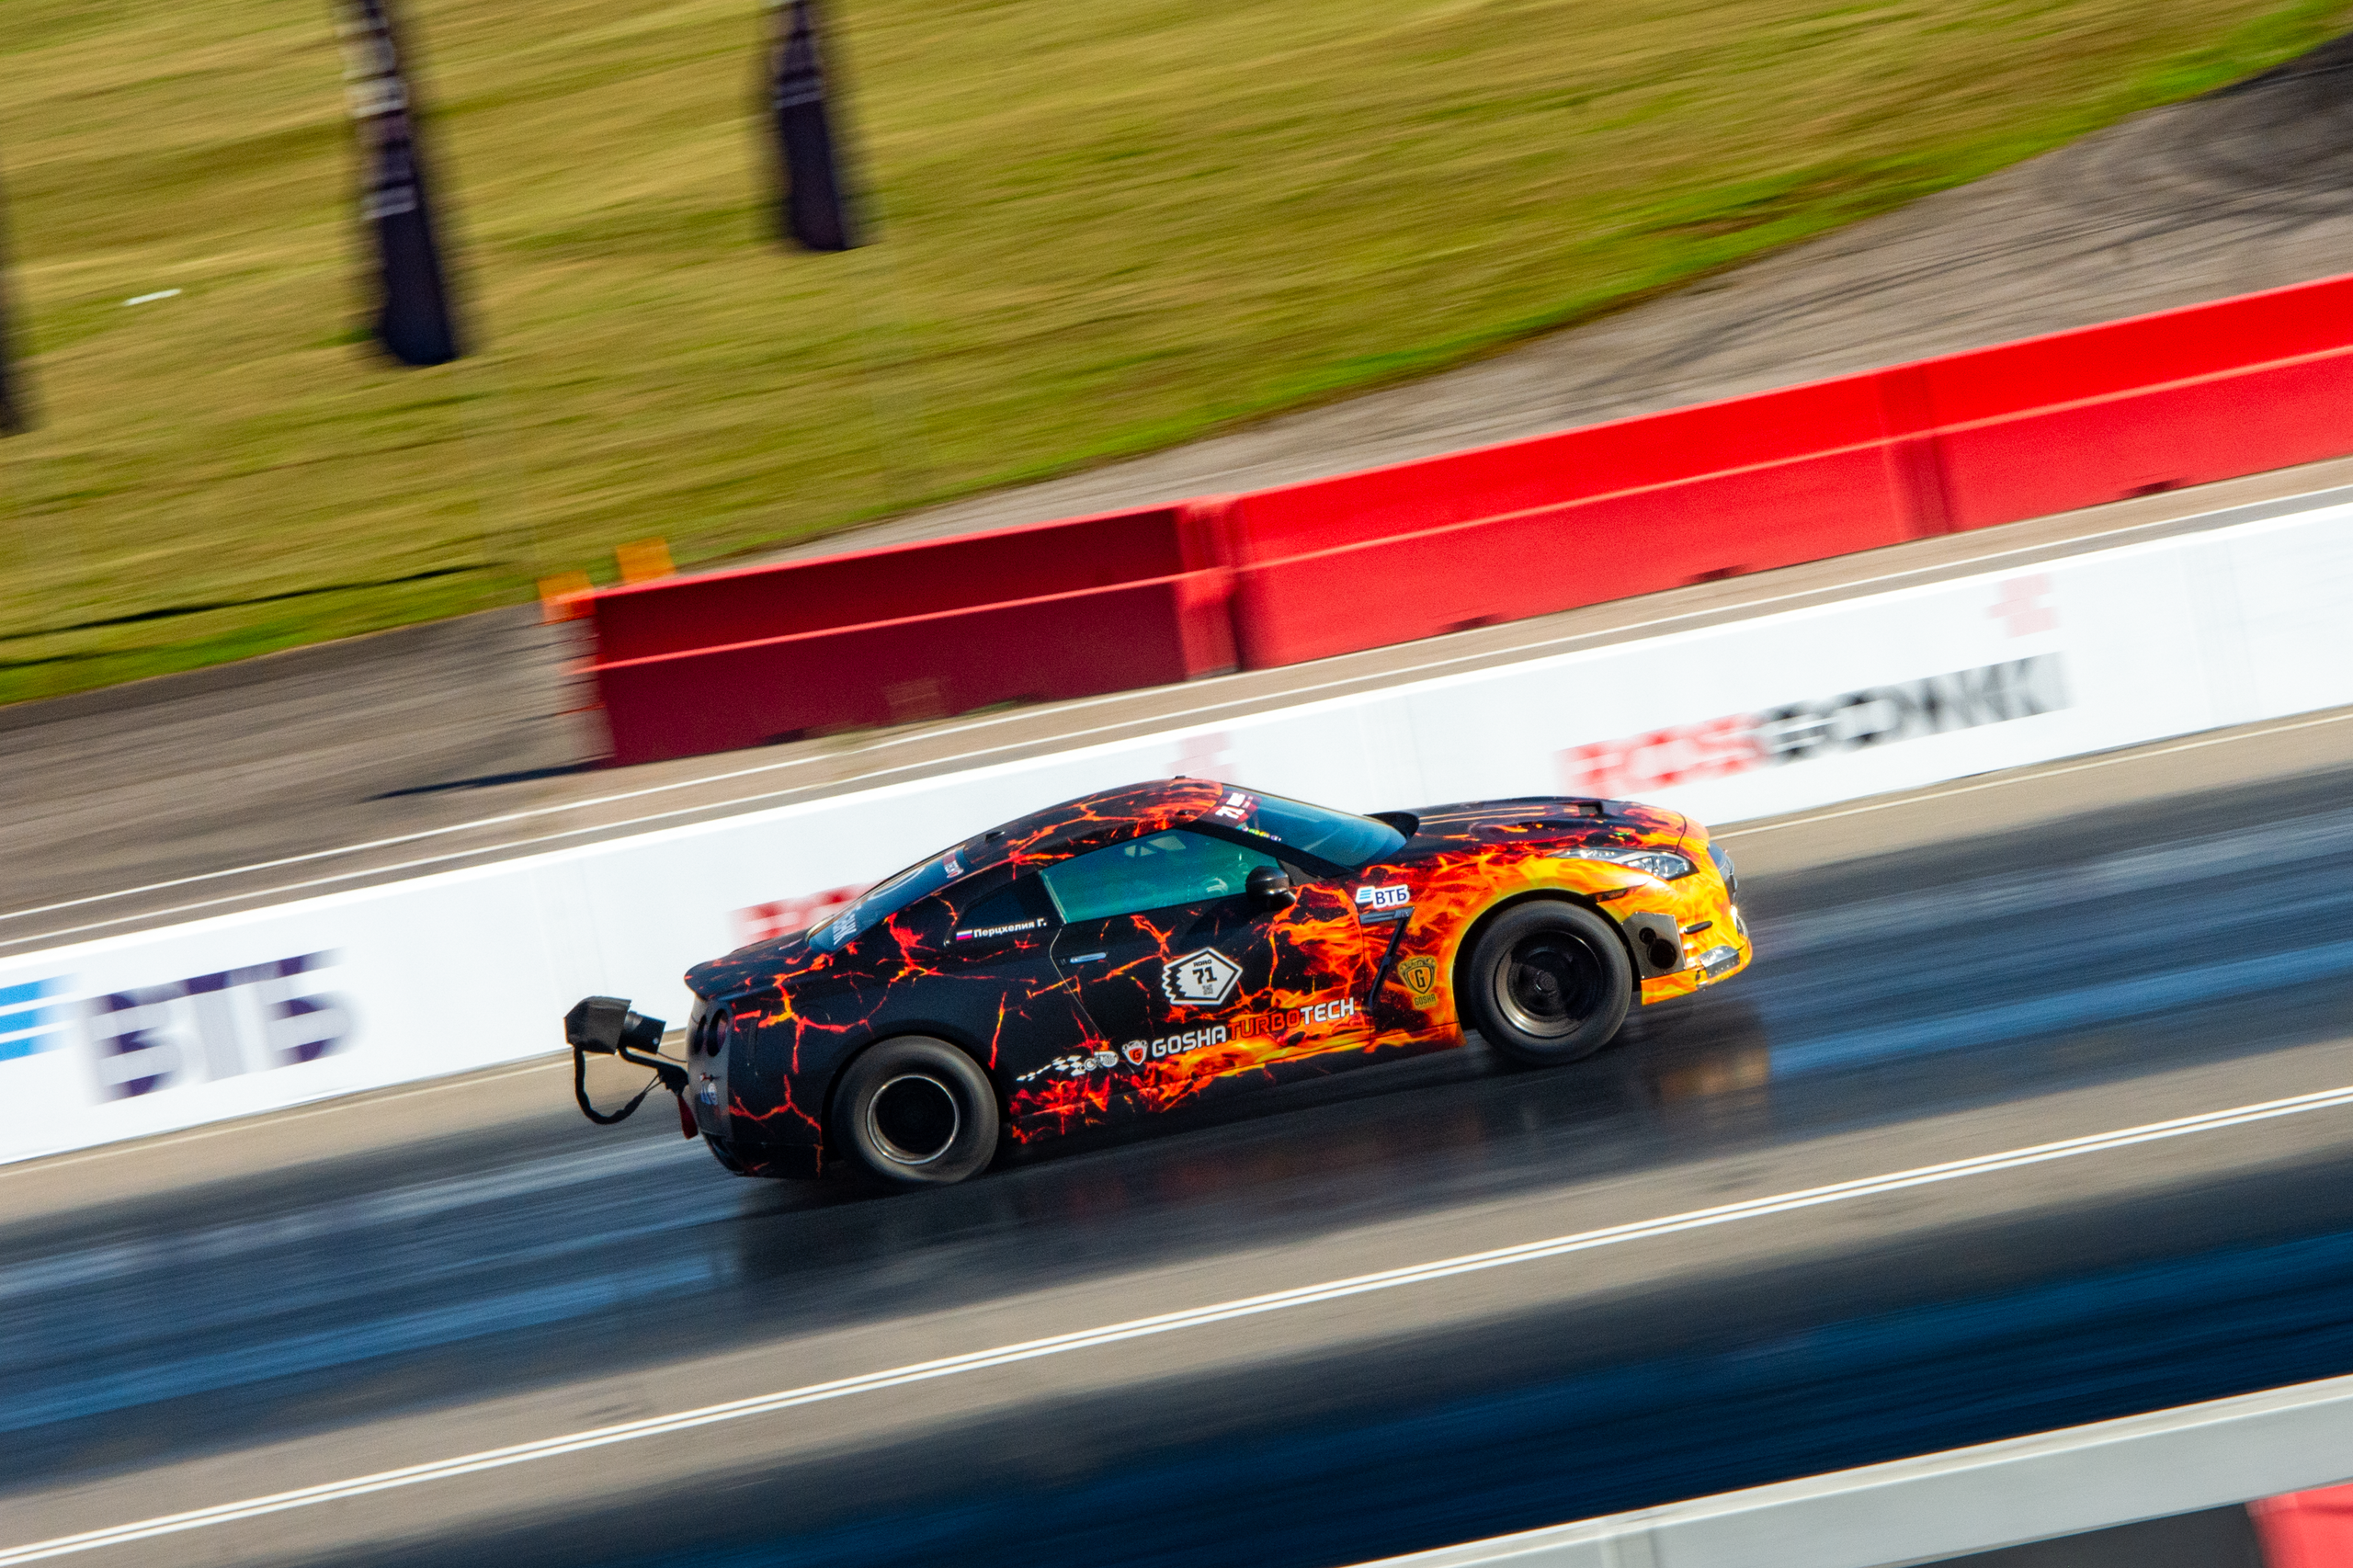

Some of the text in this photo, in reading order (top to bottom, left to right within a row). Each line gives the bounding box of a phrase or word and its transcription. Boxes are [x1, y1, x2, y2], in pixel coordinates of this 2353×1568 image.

[1374, 887, 1407, 905] ВТБ
[973, 917, 1047, 938] Перцхелия Г.
[1192, 966, 1218, 985] 71
[1414, 994, 1436, 1006] GOSHA
